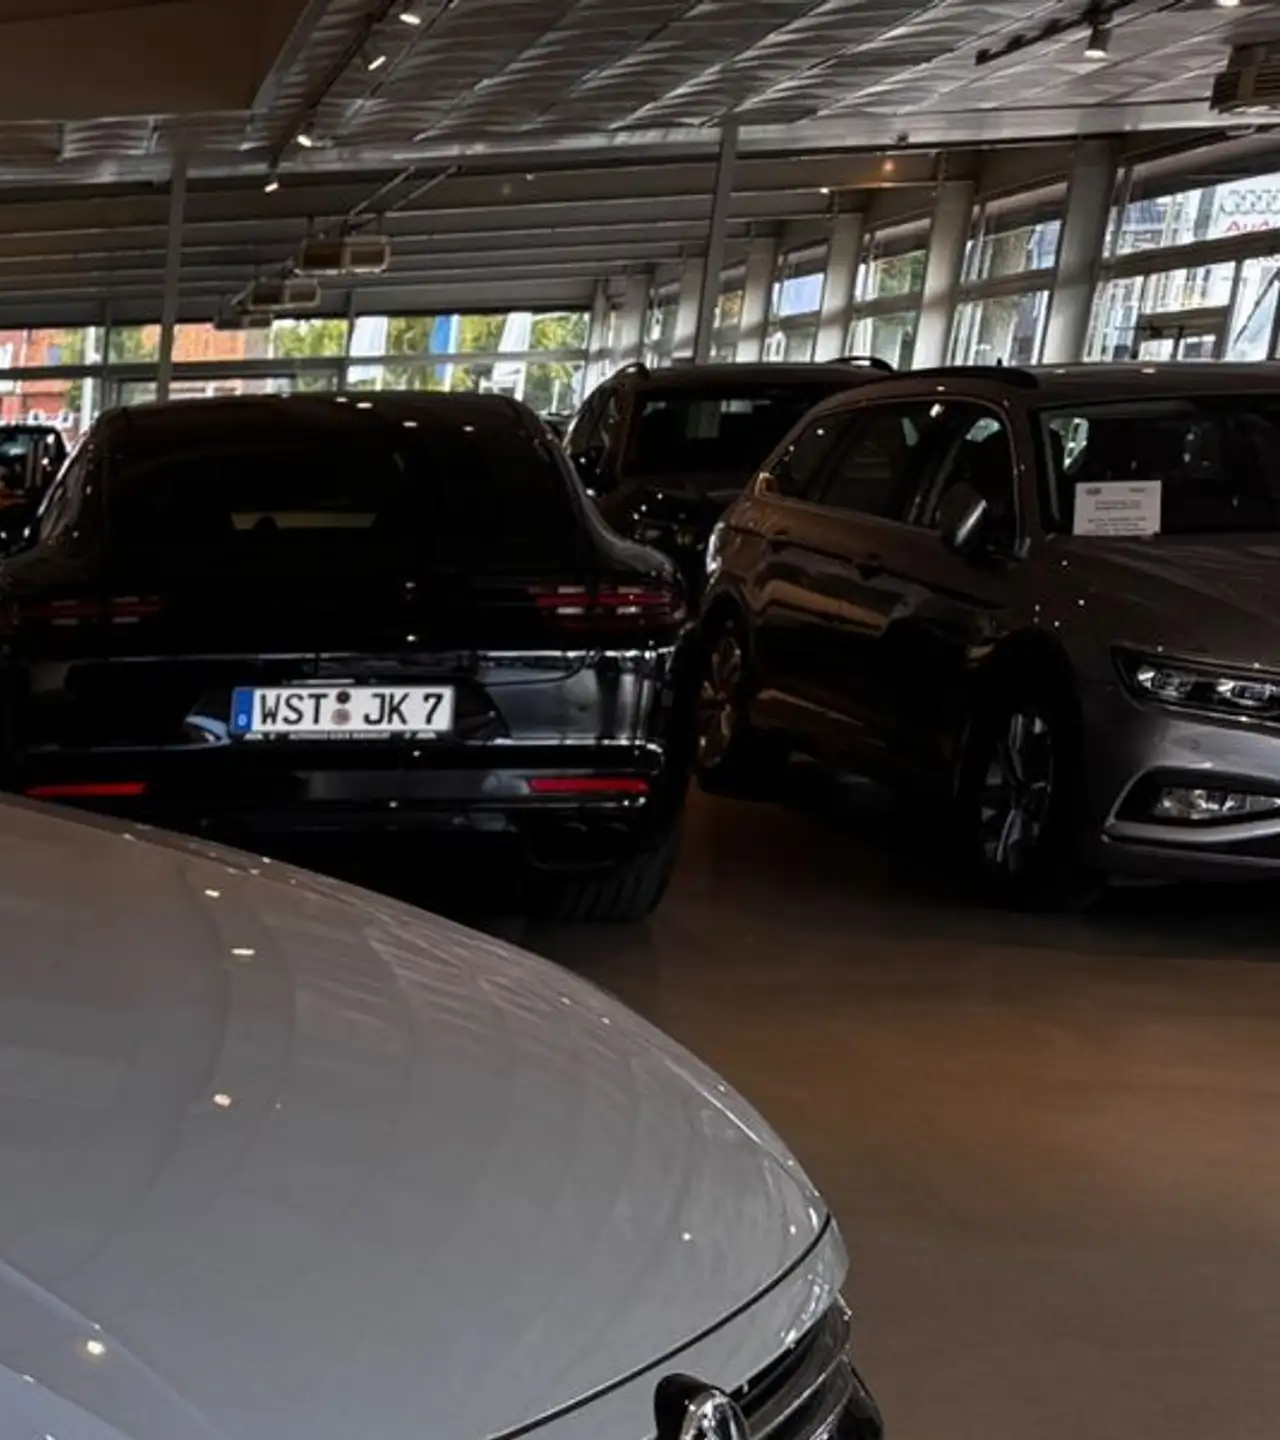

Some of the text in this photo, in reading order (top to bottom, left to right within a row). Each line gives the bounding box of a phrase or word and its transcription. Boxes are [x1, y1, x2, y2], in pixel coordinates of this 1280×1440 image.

[259, 692, 328, 726] WST
[363, 692, 410, 726] JK
[423, 692, 443, 726] 7
